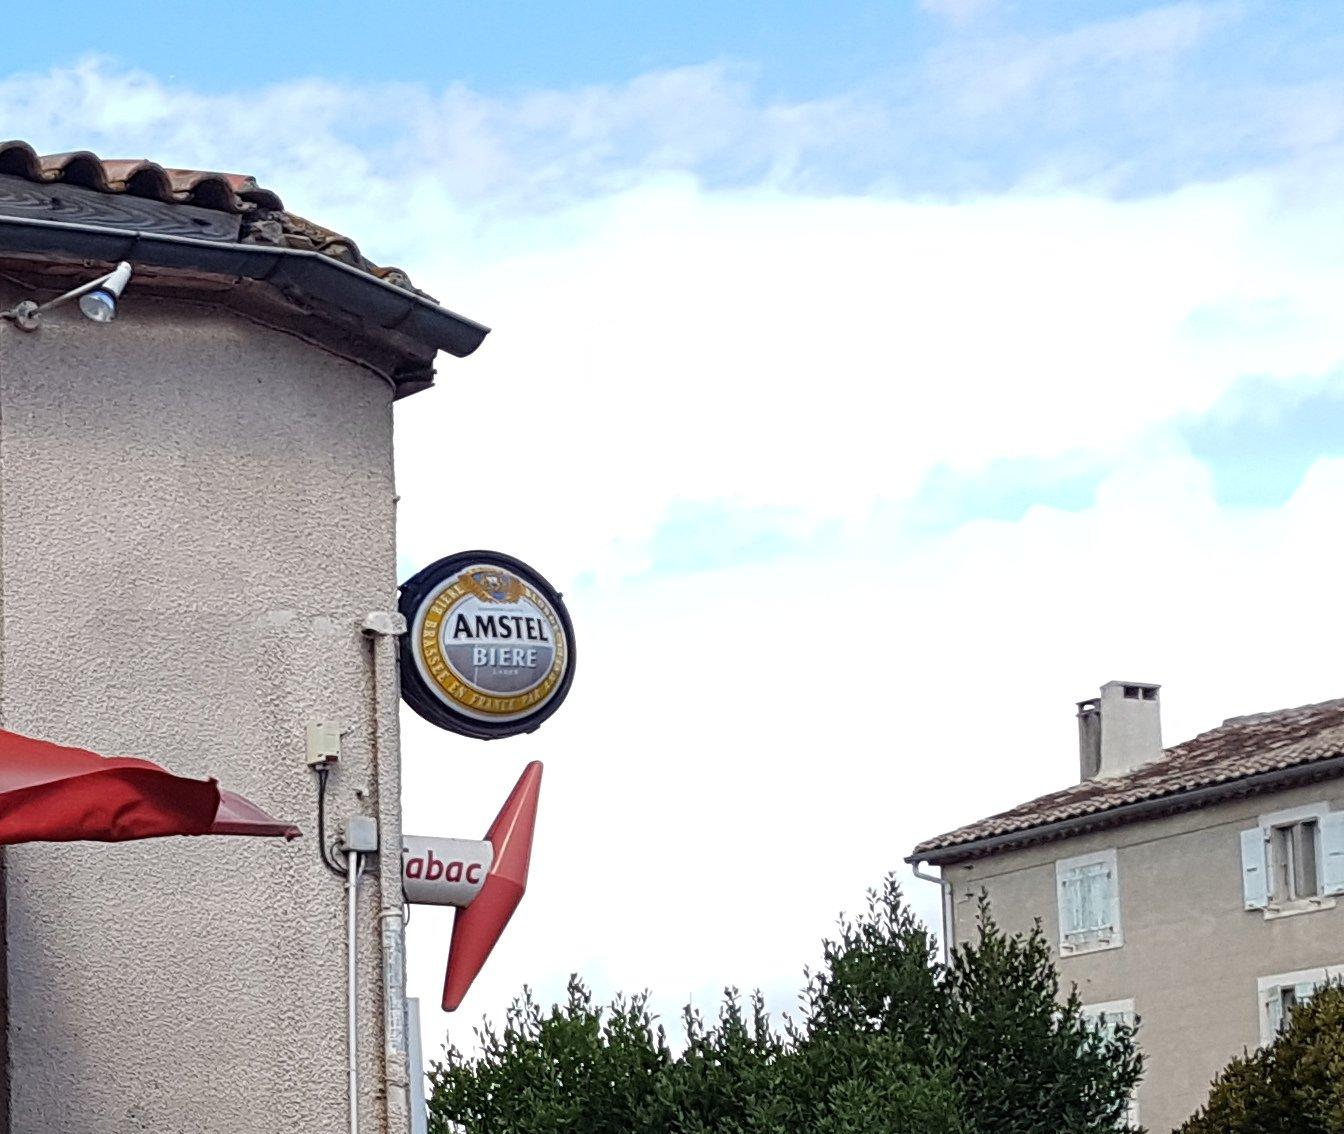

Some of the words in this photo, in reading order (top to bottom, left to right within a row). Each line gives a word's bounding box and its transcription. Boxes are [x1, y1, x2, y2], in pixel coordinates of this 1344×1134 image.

[452, 613, 549, 642] AMSTEL
[472, 646, 538, 669] BIERE
[403, 847, 482, 884] abac
